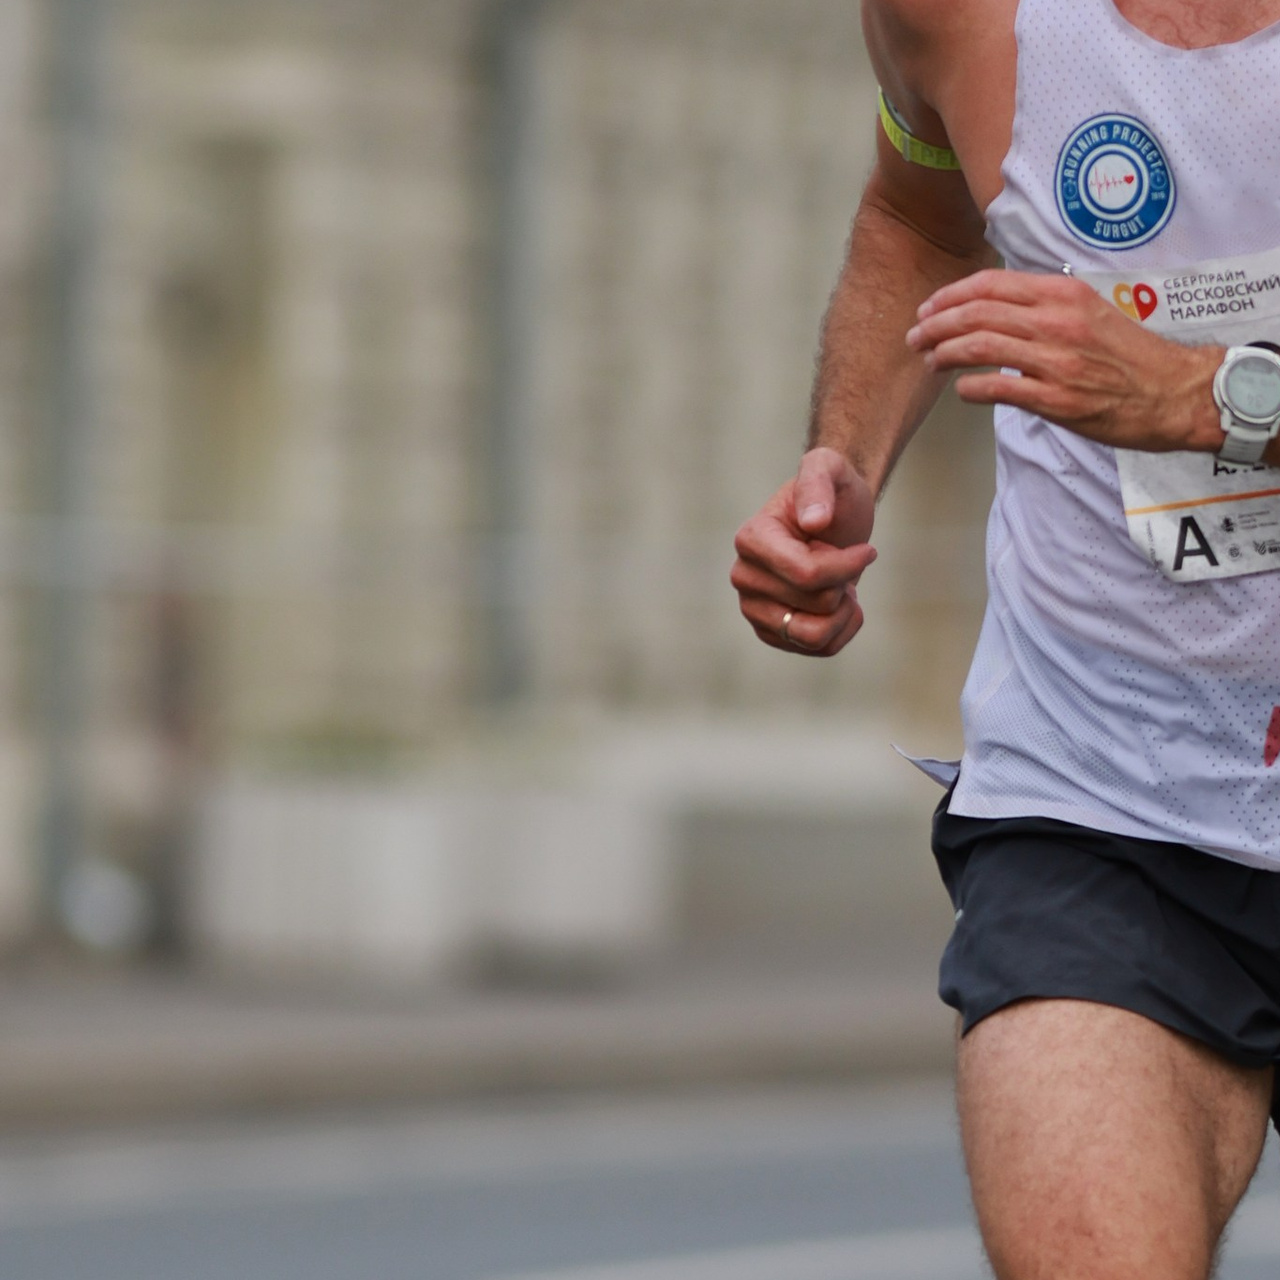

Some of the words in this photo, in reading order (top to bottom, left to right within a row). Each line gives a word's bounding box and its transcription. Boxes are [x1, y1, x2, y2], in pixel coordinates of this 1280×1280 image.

[1064, 124, 1109, 178] RUNNING
[1112, 124, 1164, 169] PROJECT
[1093, 215, 1146, 239] SURGUT
[1163, 269, 1246, 290] СБЕРПРАЙМ
[1170, 298, 1255, 321] МАРАФОН
[1172, 515, 1220, 572] A
